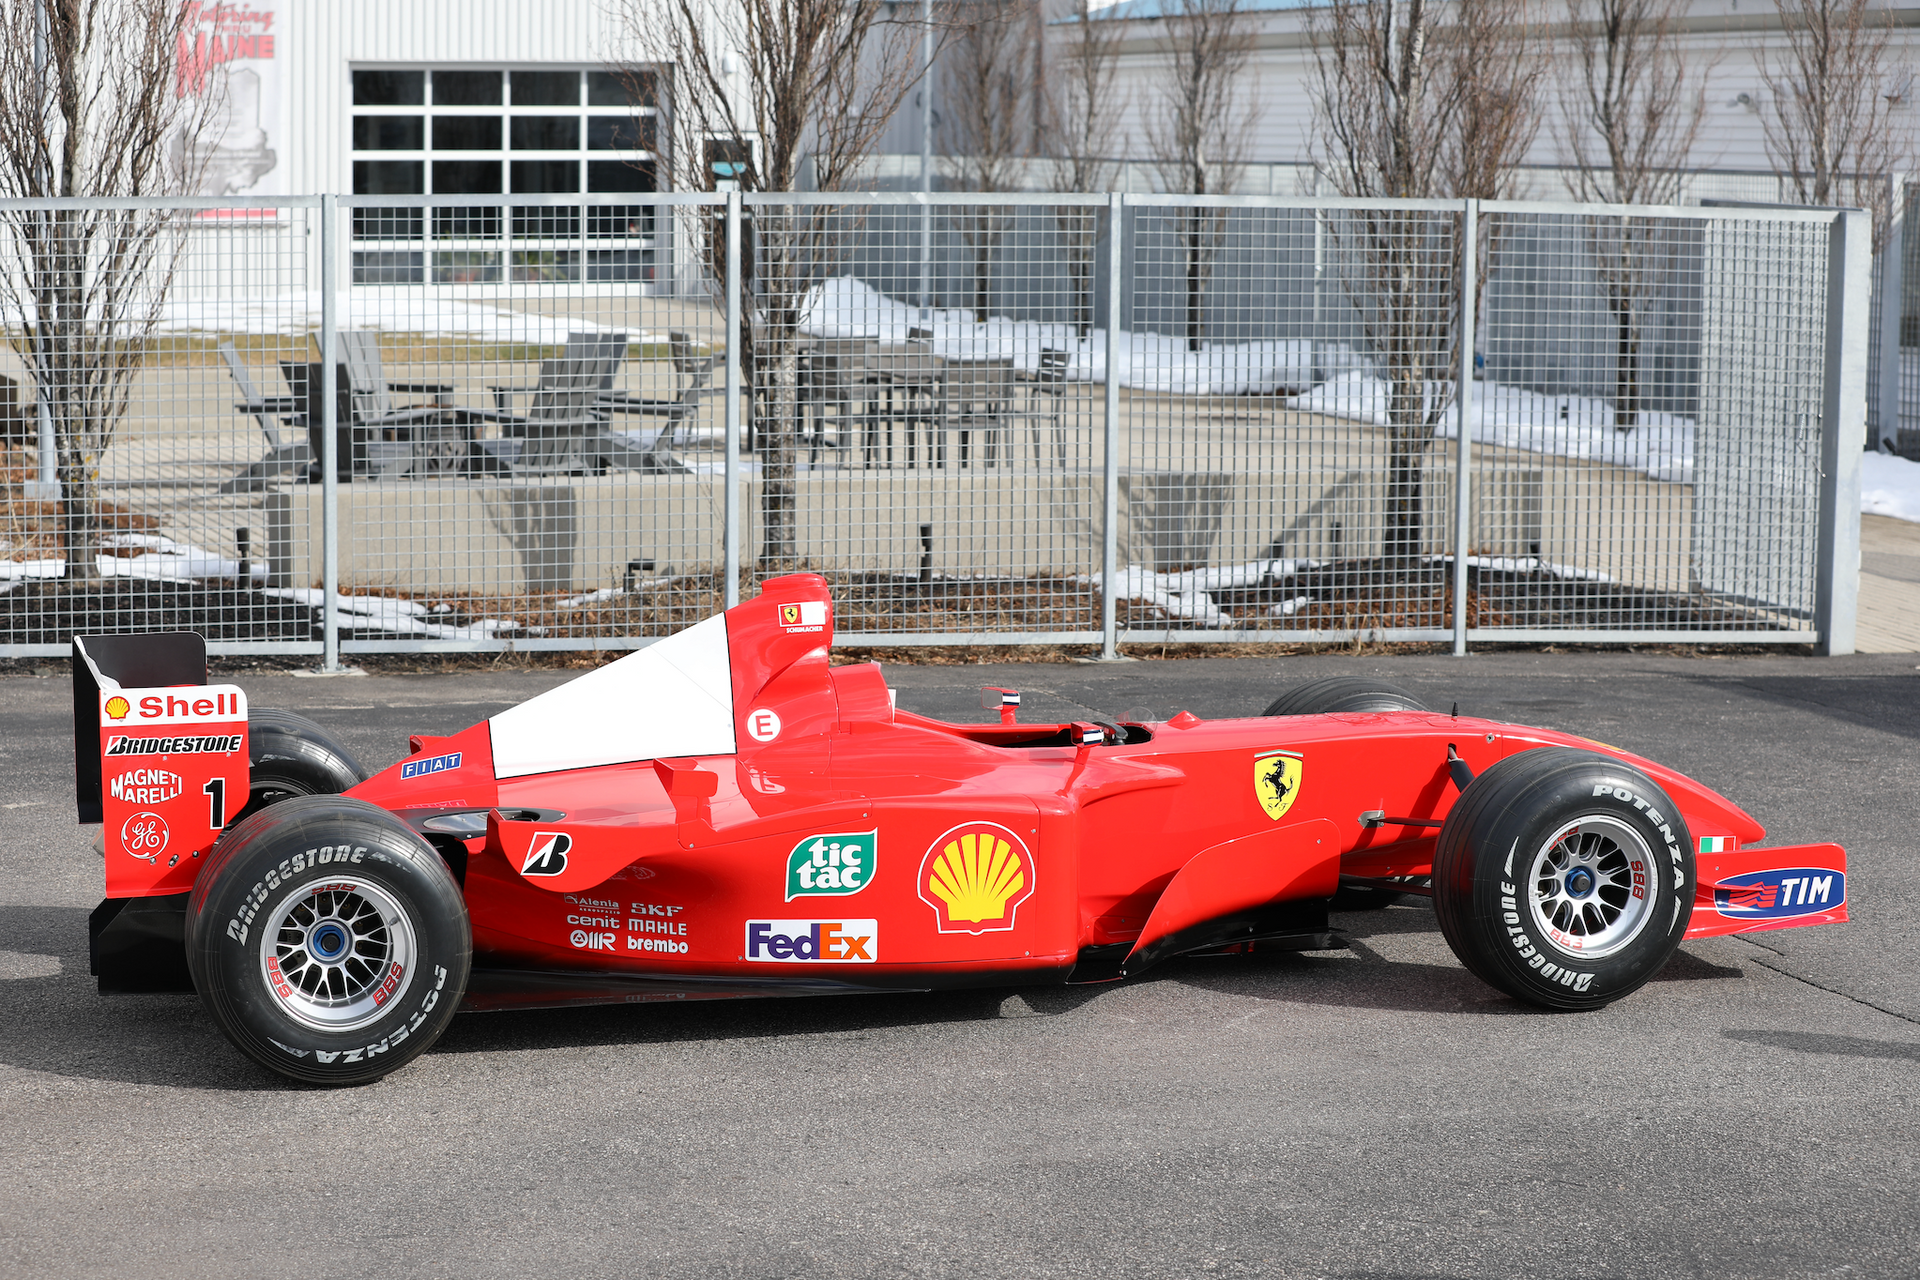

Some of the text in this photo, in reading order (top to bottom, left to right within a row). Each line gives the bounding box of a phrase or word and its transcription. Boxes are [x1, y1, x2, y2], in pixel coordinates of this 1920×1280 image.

[176, 31, 274, 99] MAINE
[786, 625, 823, 634] SCHUMACHER
[139, 693, 237, 718] Shell
[755, 714, 773, 736] E
[107, 736, 241, 755] BRIDGESTONE
[405, 755, 459, 776] FIAT
[111, 769, 182, 793] MAGNETI
[111, 781, 182, 804] MARELLI
[203, 778, 226, 829] 1
[1592, 784, 1684, 892] POTENZA
[808, 838, 862, 867] tic
[796, 861, 861, 889] tac
[1631, 860, 1645, 900] BBS
[226, 844, 368, 946] BRIDGESTONE
[579, 897, 620, 908] Alenia
[1781, 876, 1833, 906] TIM
[567, 915, 620, 929] cenit
[631, 902, 683, 916] SKF
[628, 918, 687, 936] MAHLE
[1501, 881, 1595, 992] BRIDGESTONE
[627, 935, 689, 954] brembo
[749, 923, 872, 960] FedEx
[267, 956, 293, 999] BBS
[373, 961, 403, 1006] BBS
[316, 964, 448, 1064] POTENZA
